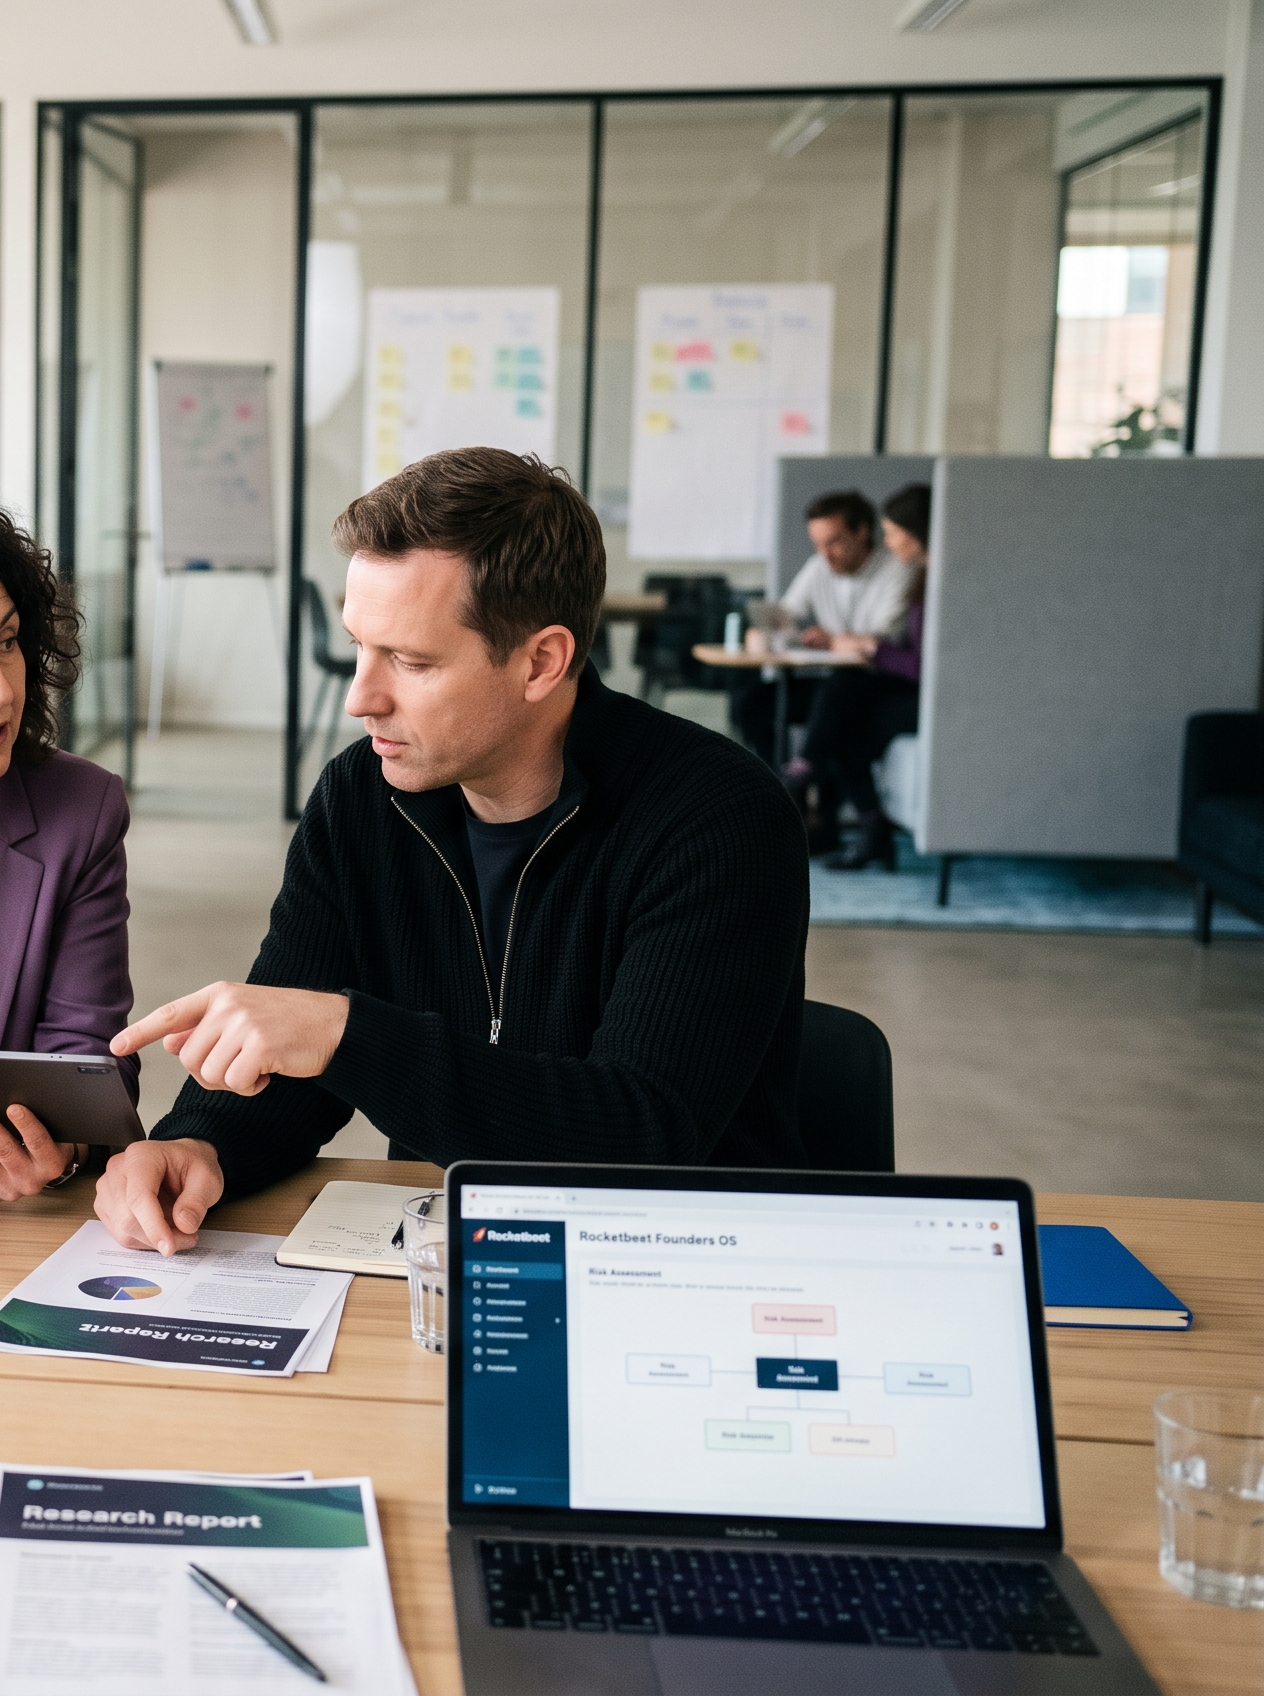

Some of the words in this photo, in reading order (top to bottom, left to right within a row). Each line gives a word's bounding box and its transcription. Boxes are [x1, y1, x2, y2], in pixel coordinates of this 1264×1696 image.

[655, 1233, 715, 1246] Founders
[718, 1235, 738, 1246] OS
[22, 1504, 156, 1526] Research
[163, 1510, 263, 1531] Report
